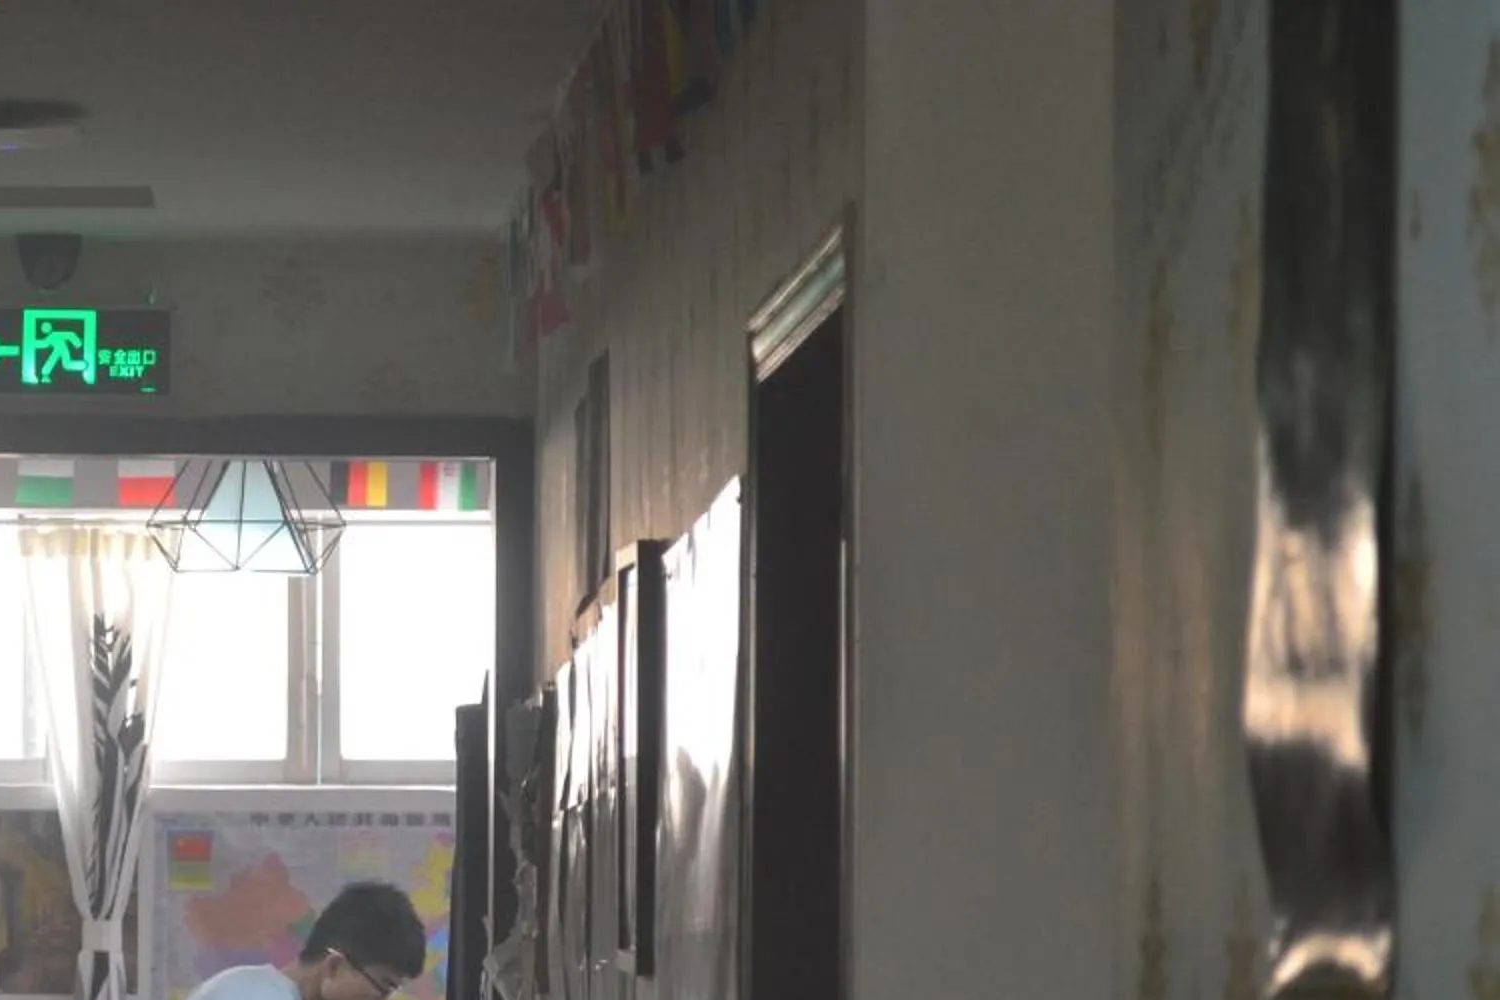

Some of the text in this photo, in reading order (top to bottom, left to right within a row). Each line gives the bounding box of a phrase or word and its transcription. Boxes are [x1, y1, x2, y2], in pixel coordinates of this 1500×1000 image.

[98, 349, 156, 365] 安全出口
[109, 366, 144, 377] EXIT
